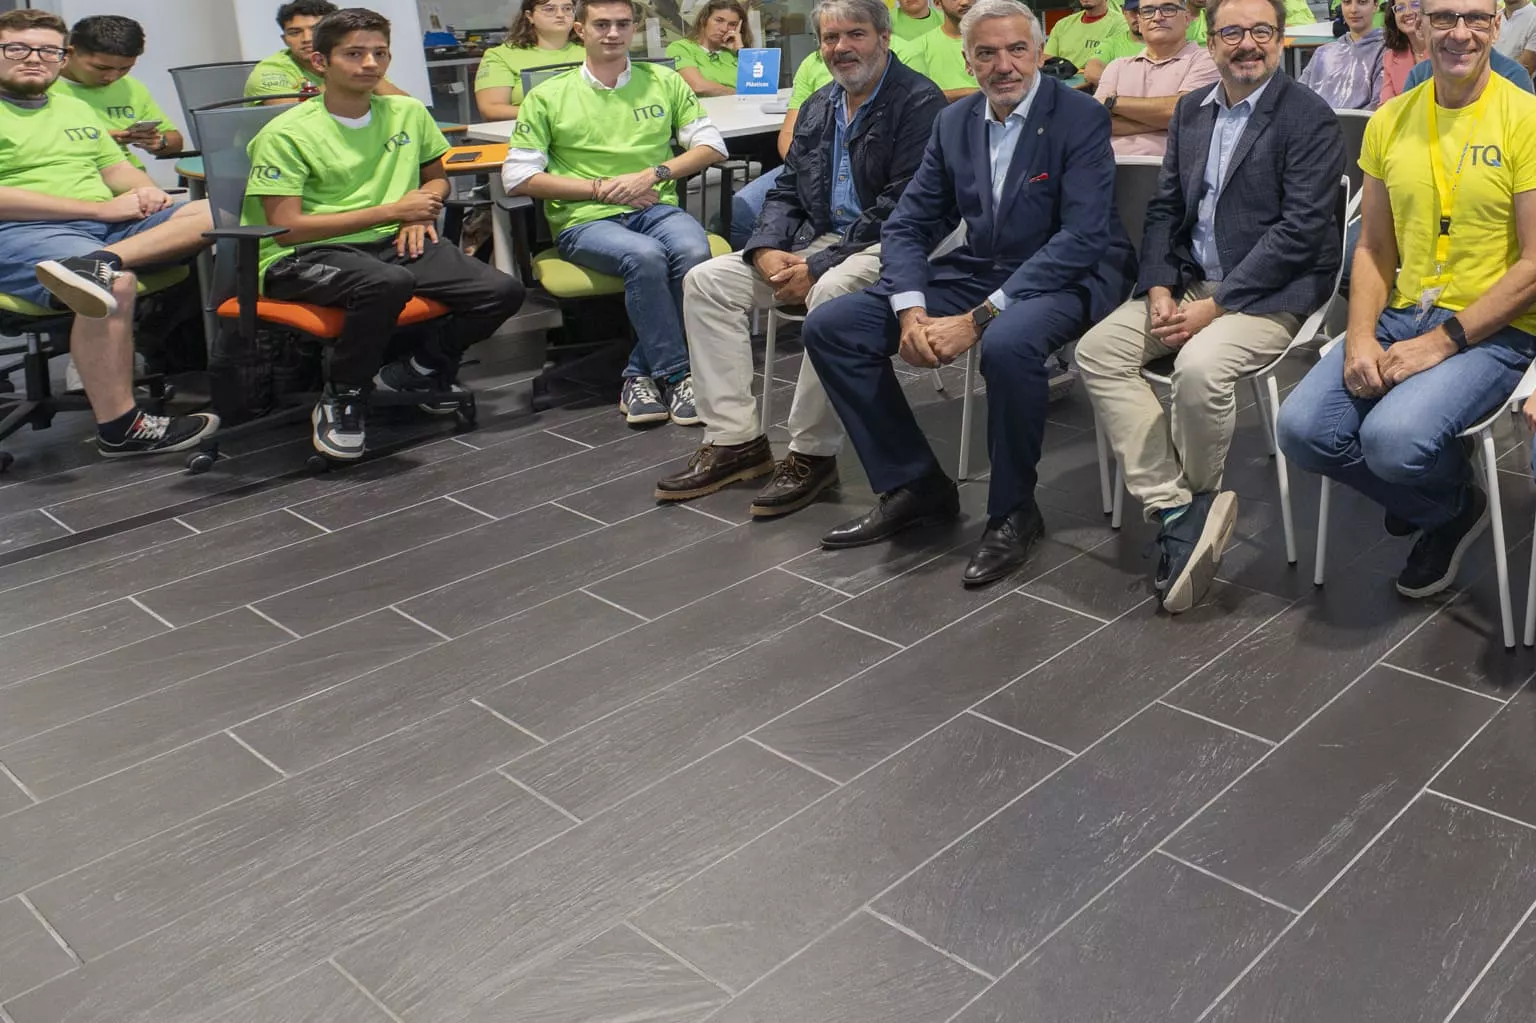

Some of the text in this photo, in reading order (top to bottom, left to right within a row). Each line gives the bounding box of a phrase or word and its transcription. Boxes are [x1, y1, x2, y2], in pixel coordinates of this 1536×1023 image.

[106, 106, 136, 119] ITQ
[632, 104, 665, 122] ITQ
[63, 126, 101, 142] ITQ
[1470, 144, 1503, 168] TQ
